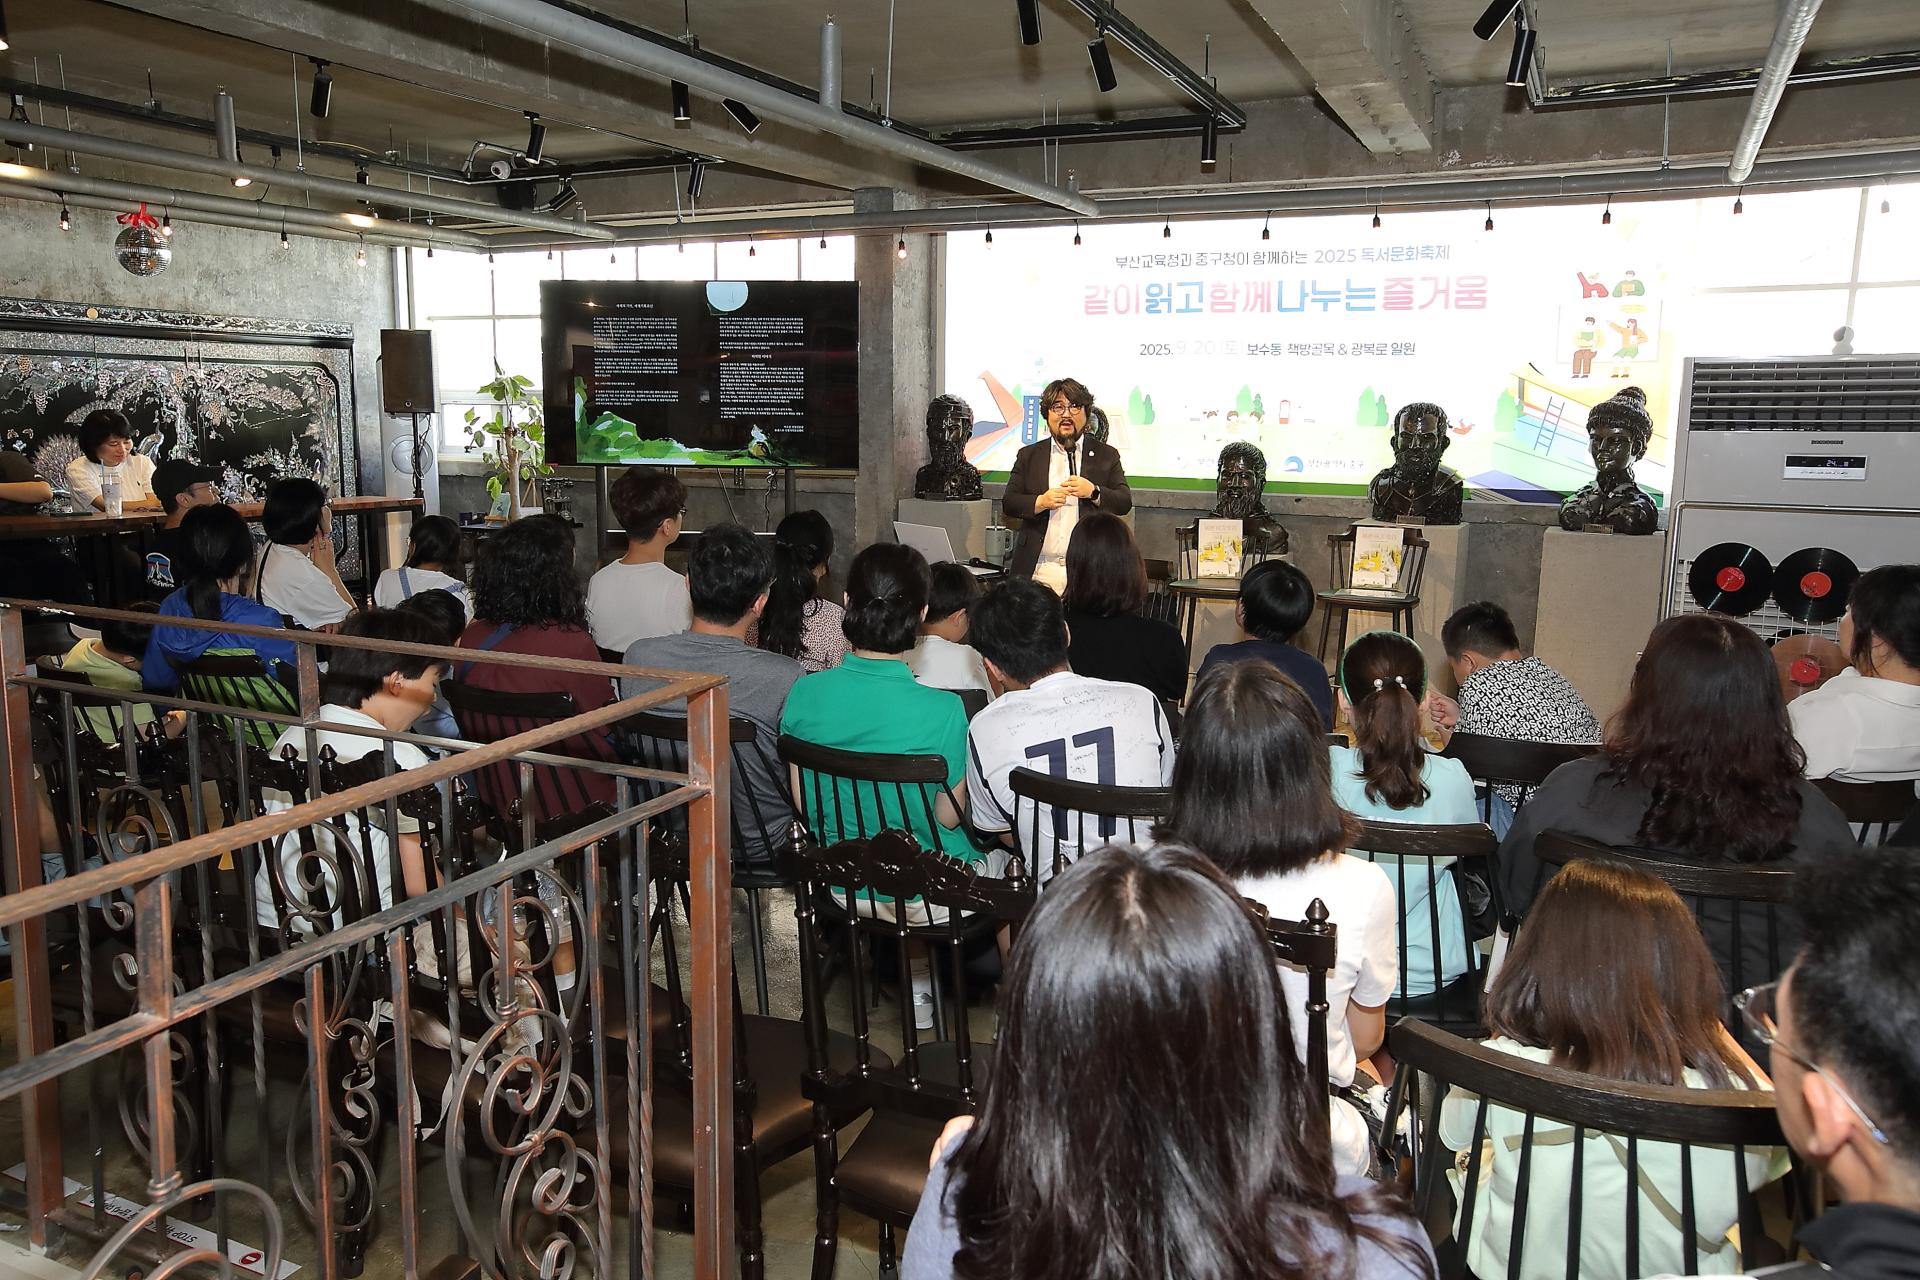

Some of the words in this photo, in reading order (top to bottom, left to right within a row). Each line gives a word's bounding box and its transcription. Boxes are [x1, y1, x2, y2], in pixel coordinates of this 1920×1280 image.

[1115, 253, 1192, 269] 부산교육청과
[1195, 252, 1249, 266] 중구청이
[1253, 250, 1308, 265] 함께하는
[1314, 248, 1357, 264] 2025
[1361, 245, 1450, 263] 독서문화축제
[1084, 283, 1140, 315] 같이
[1145, 281, 1204, 314] 읽고
[1210, 280, 1271, 313] 함께
[1277, 278, 1376, 313] 나누는
[1382, 275, 1488, 311] 즐거움
[1139, 343, 1174, 356] 2025.
[1247, 343, 1282, 356] 보수동
[1287, 343, 1335, 356] 책방골목
[1338, 343, 1348, 356] &
[1351, 342, 1388, 356] 광복로
[1391, 342, 1416, 356] 일원
[172, 1231, 197, 1243] STOP
